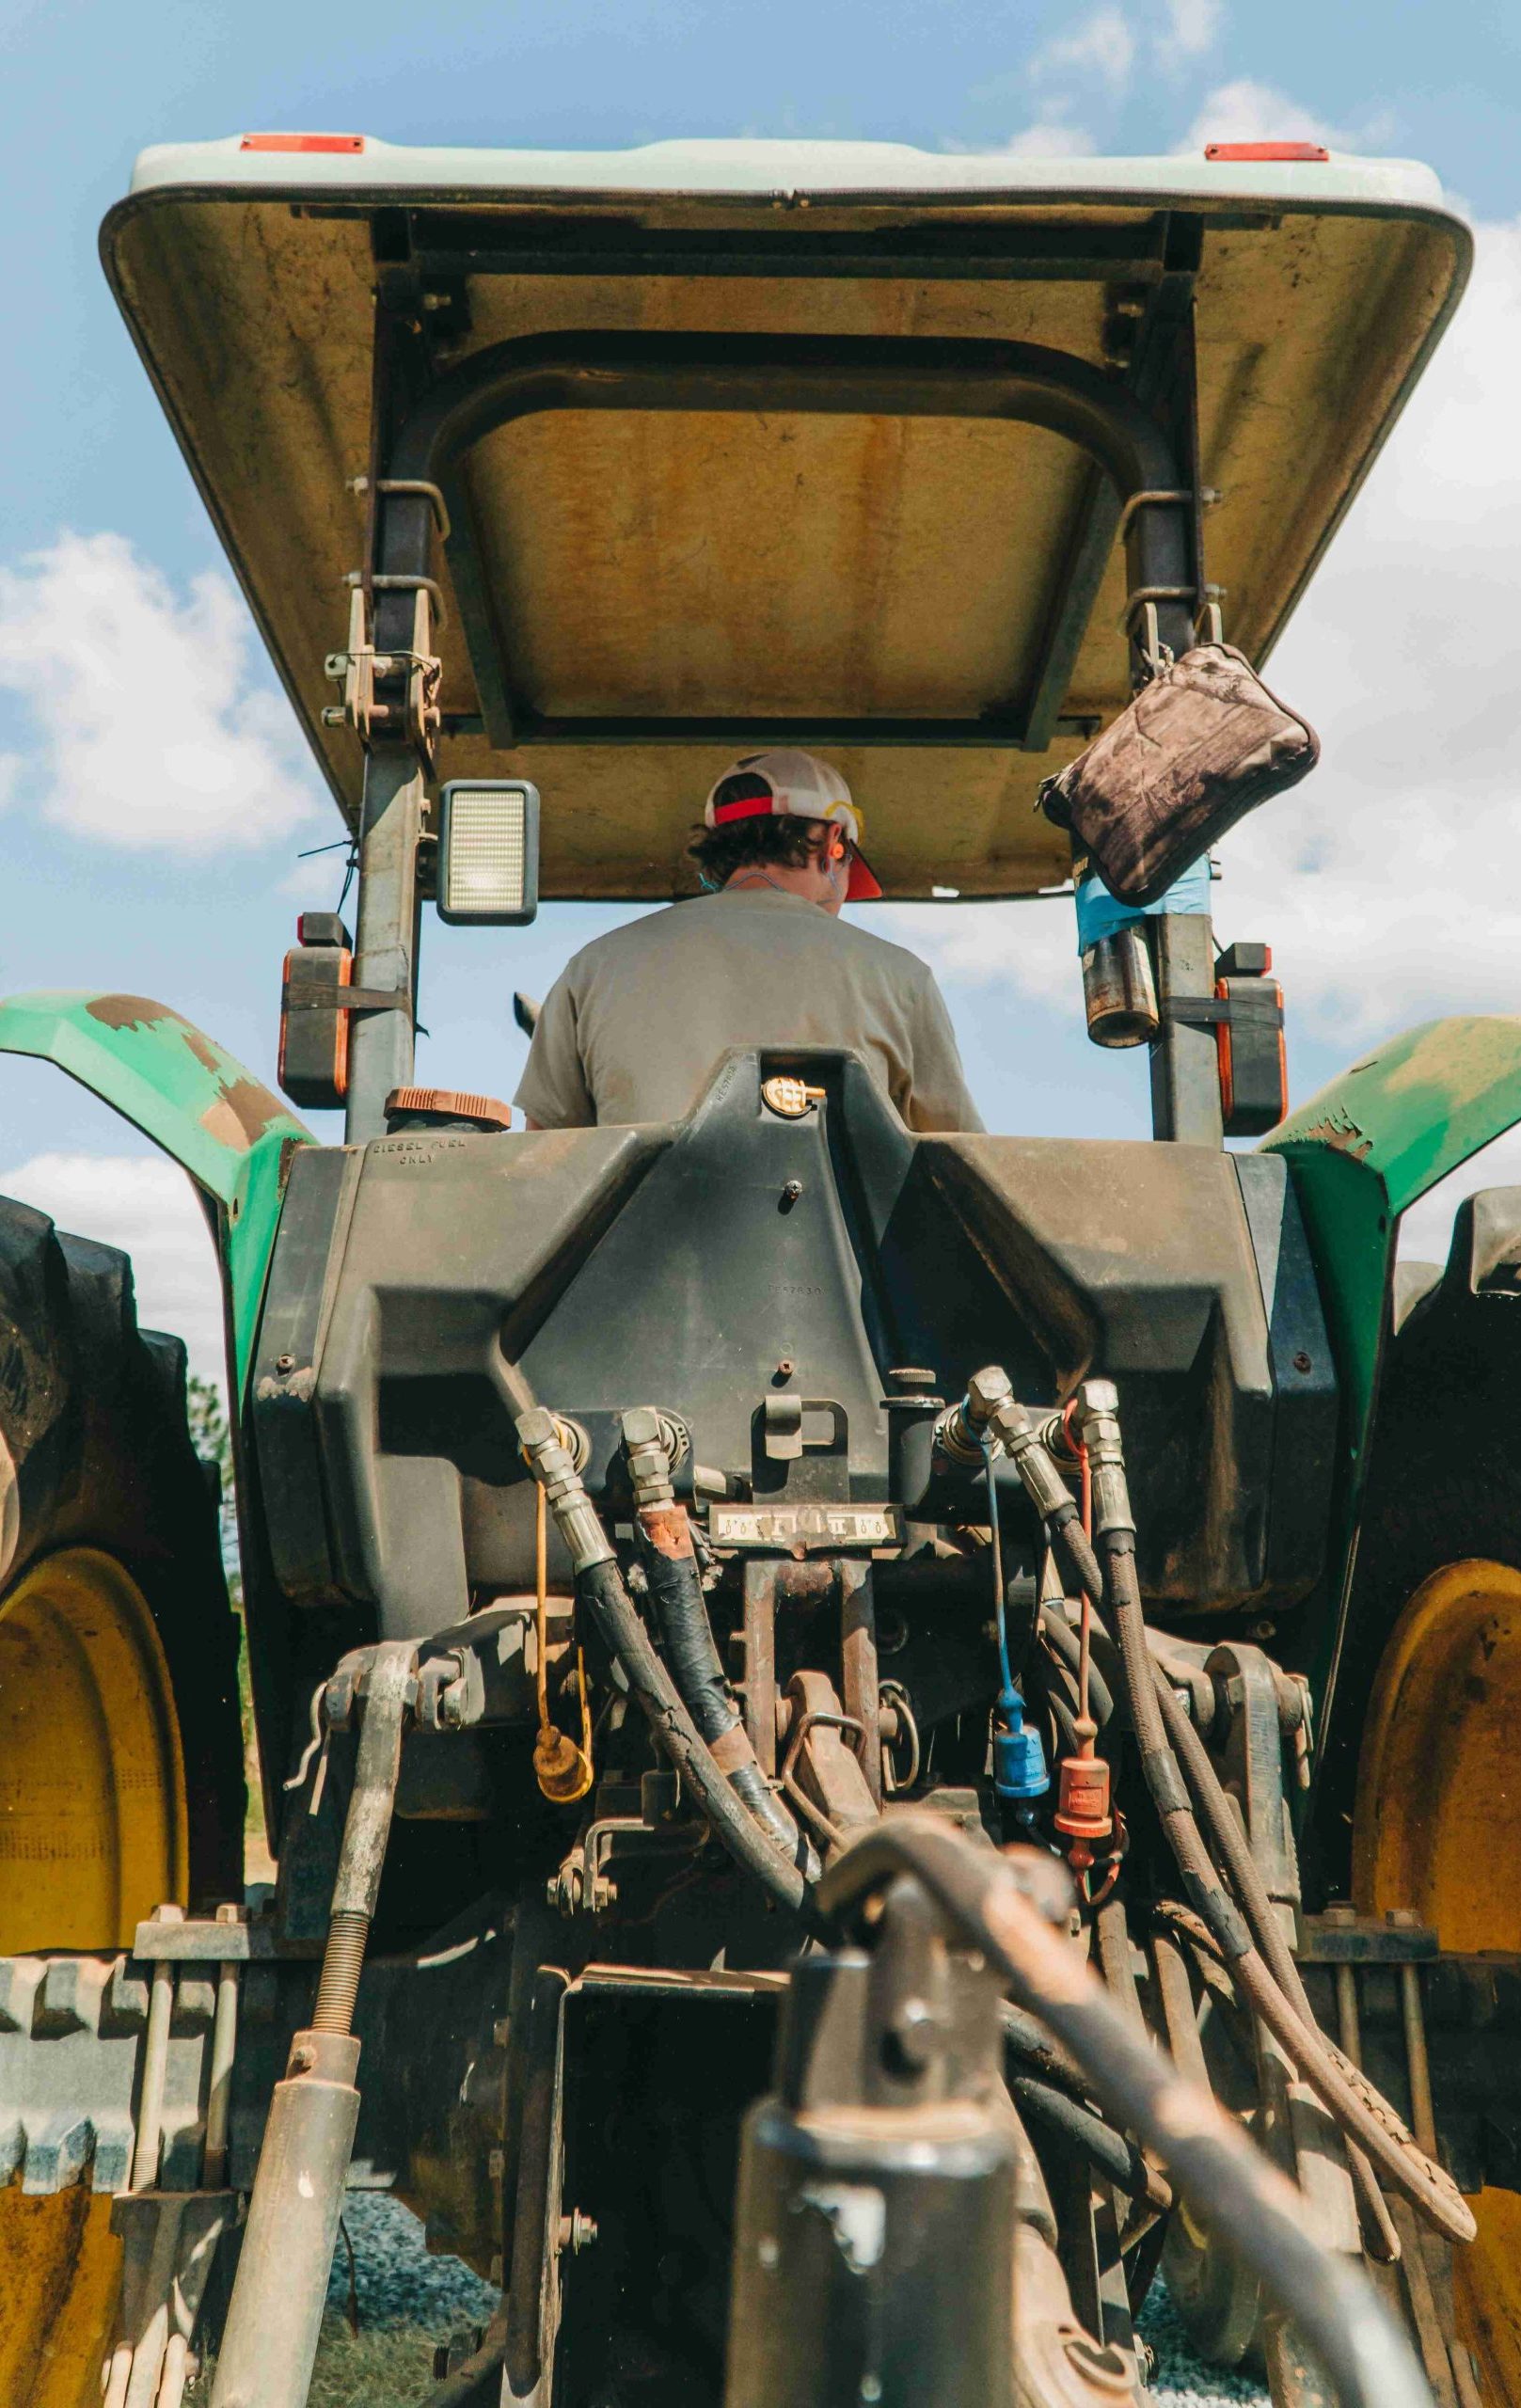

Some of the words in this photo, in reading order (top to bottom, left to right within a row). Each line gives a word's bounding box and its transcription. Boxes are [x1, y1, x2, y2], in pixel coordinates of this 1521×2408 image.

[373, 1141, 423, 1153] DIESEL
[431, 1139, 466, 1149] FUEL
[399, 1154, 434, 1165] ONLY
